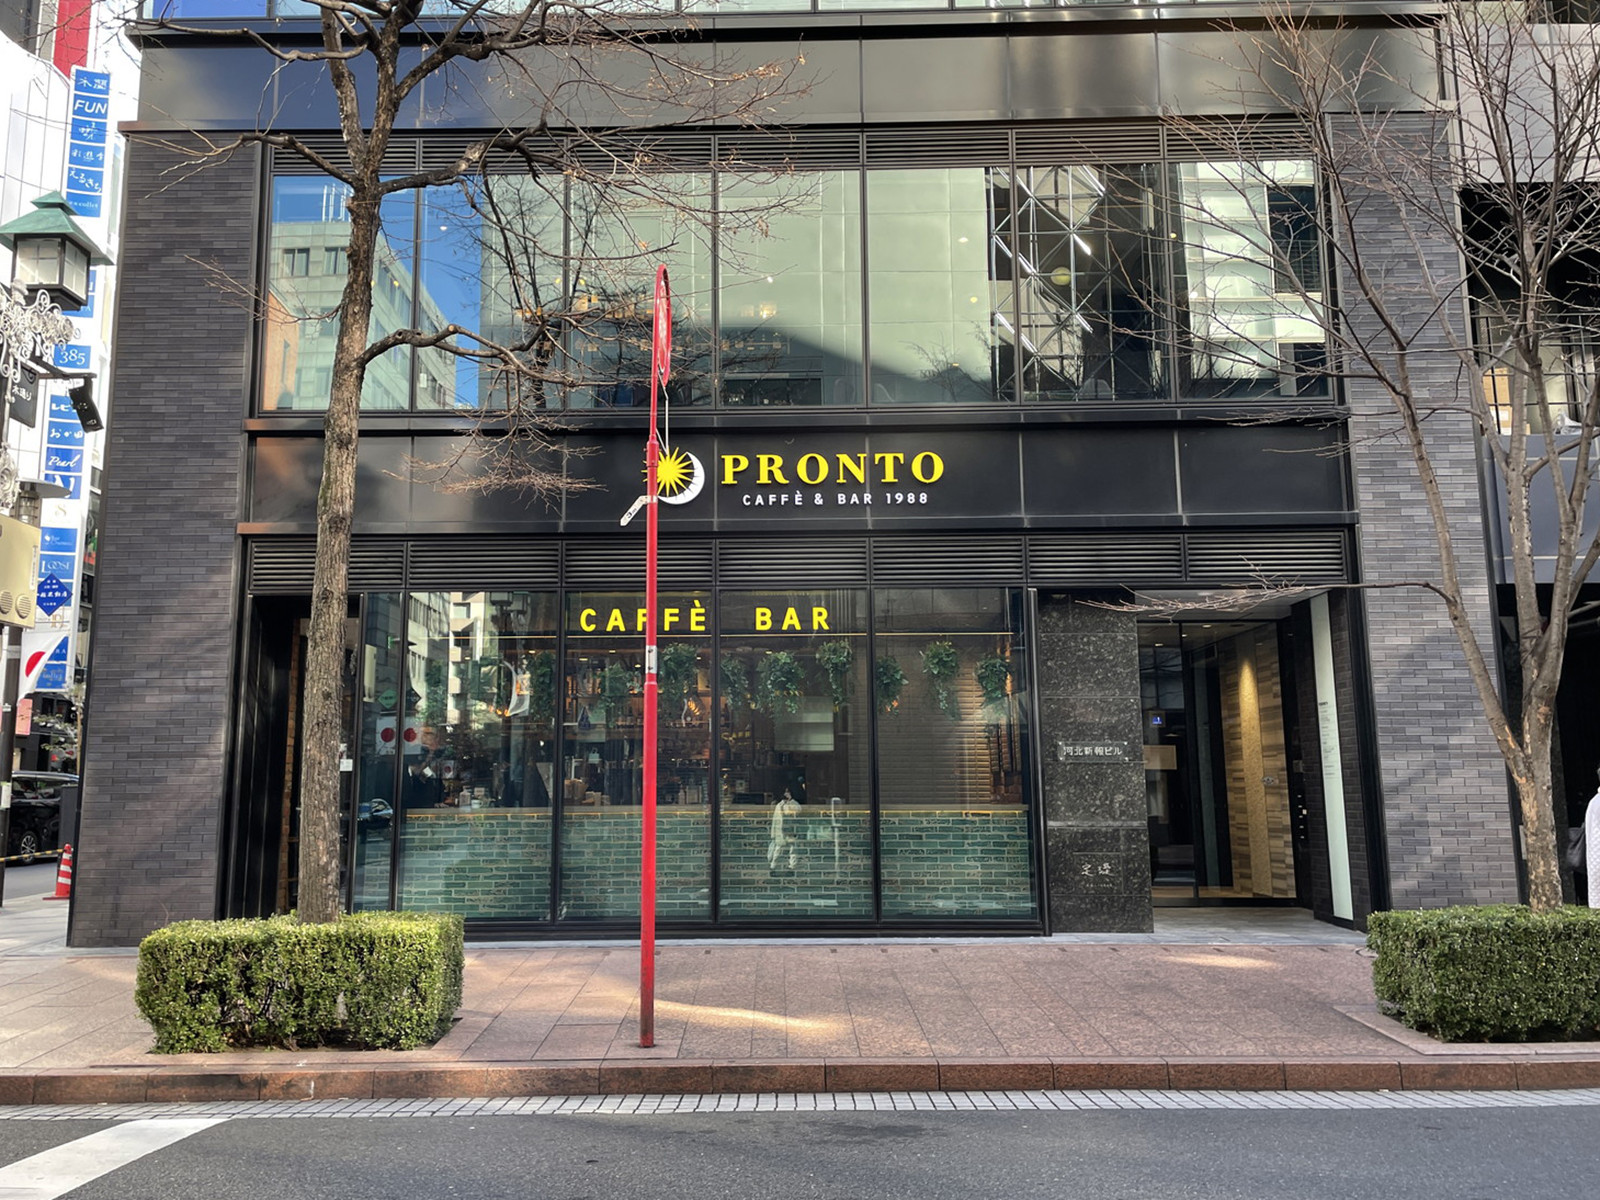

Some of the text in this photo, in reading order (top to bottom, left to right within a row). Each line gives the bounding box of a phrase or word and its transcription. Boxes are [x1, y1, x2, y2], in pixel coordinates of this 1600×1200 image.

[74, 100, 107, 114] FUN
[59, 349, 86, 365] 385
[48, 454, 81, 468] Pearl
[721, 451, 945, 485] PRONTO
[742, 490, 929, 506] CAFFÈ & BAR 1988
[579, 600, 829, 632] CAFFÈ BAR
[1063, 746, 1123, 756] 河北新報ビル
